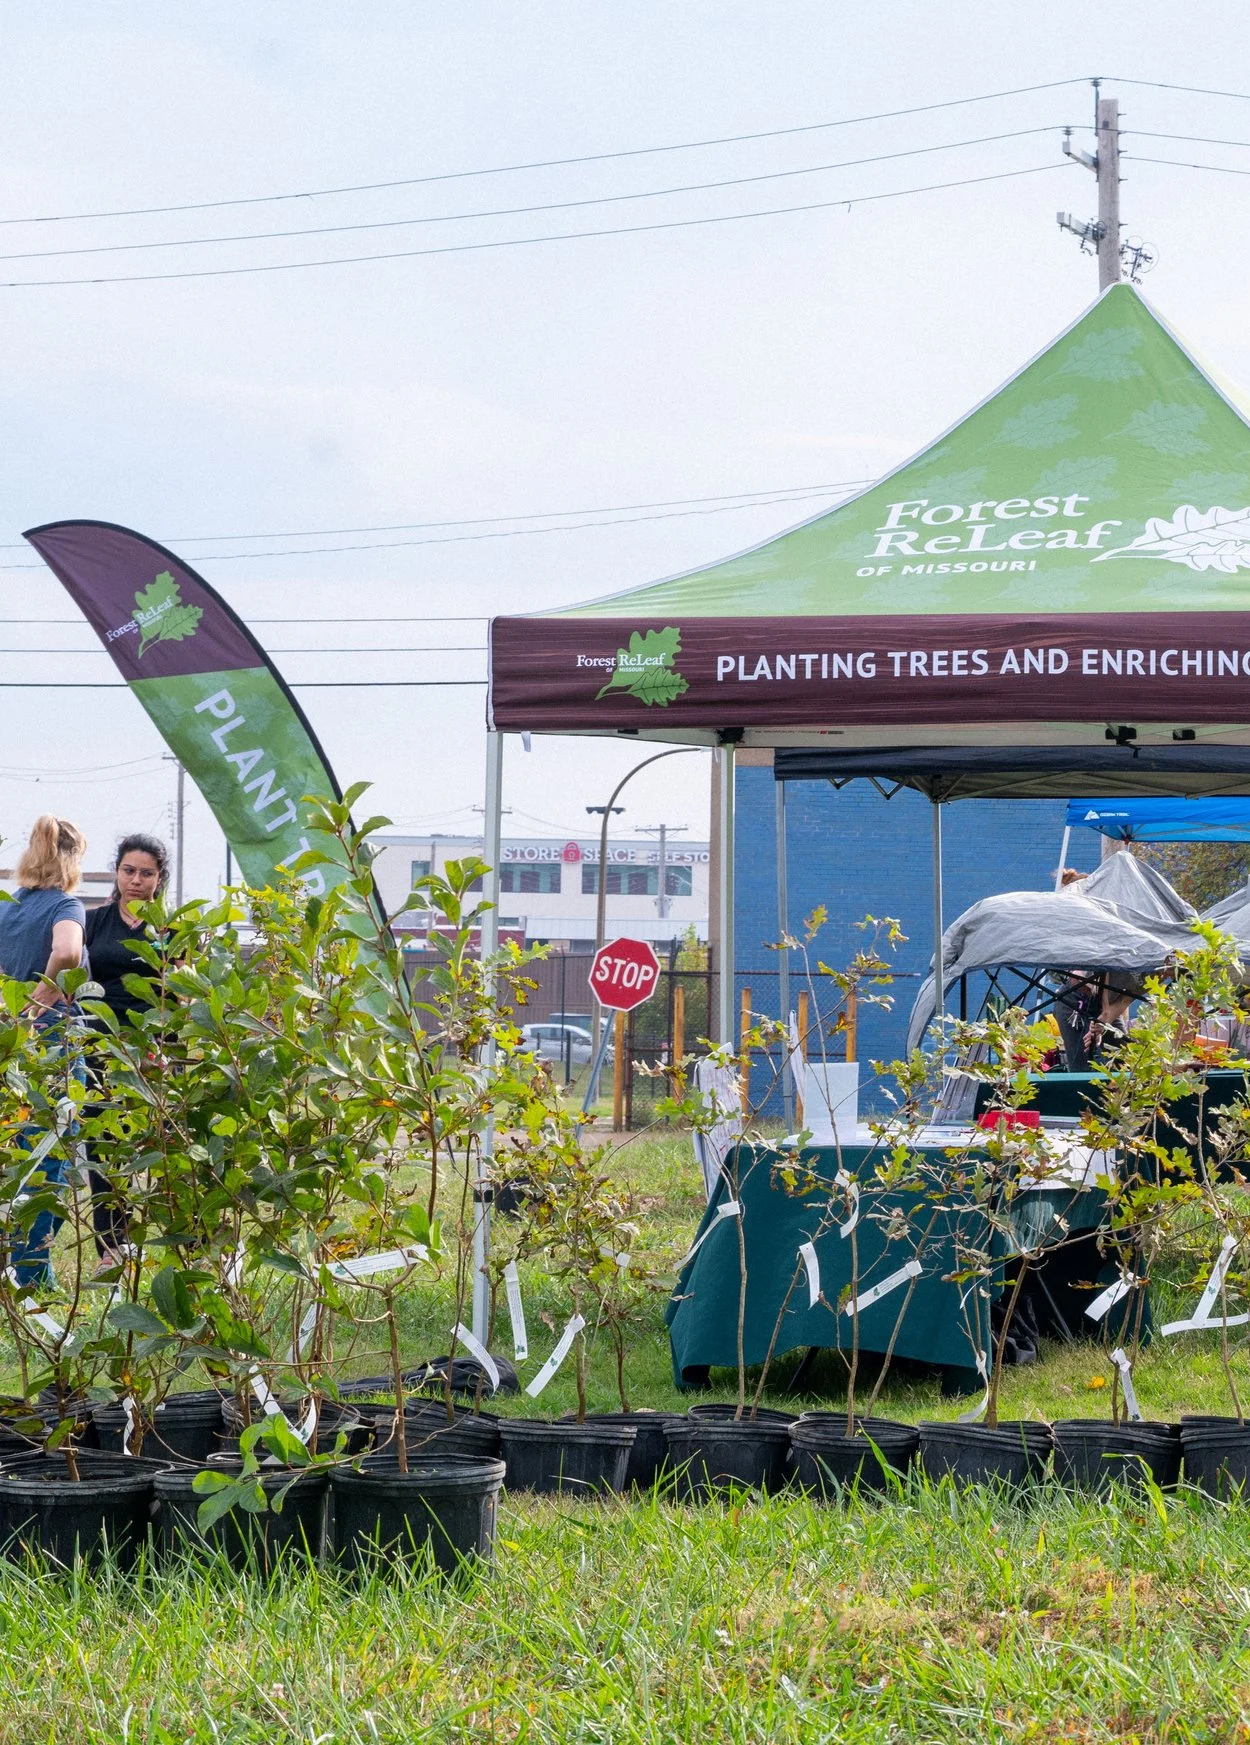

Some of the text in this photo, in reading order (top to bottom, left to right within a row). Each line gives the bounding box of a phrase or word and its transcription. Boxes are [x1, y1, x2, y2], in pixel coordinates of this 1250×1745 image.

[876, 493, 1090, 531] Forest
[864, 520, 1124, 559] ReLeaf
[856, 560, 1036, 578] OF MISSOURI
[104, 619, 139, 643] Forest
[136, 595, 174, 624] ReLeaf
[576, 652, 666, 667] Forest ReLeaf
[717, 652, 876, 681] PLANTING
[887, 649, 989, 677] TREES
[999, 648, 1070, 675] AND
[194, 688, 297, 833] PLANT
[503, 846, 560, 862] STORE
[595, 956, 655, 991] STOP
